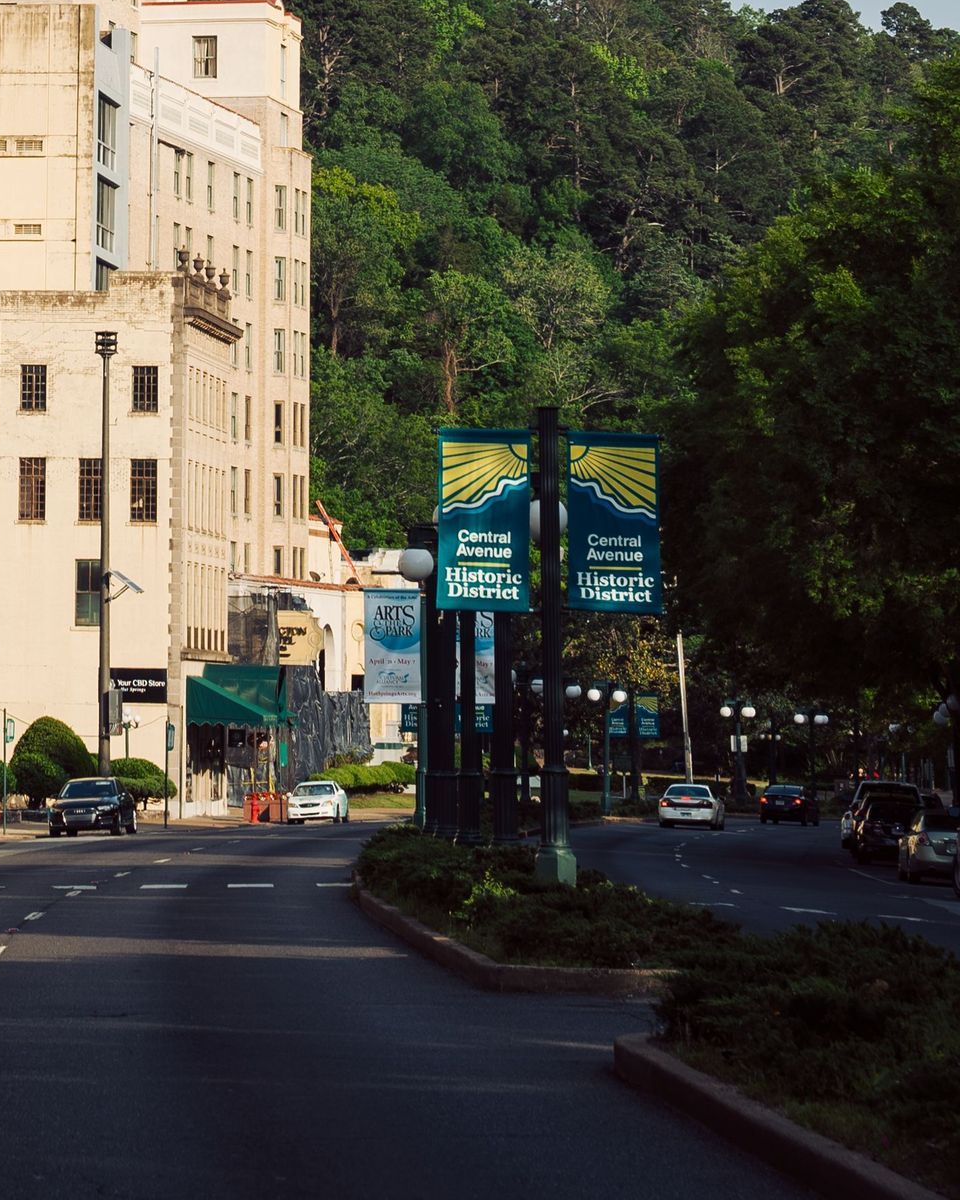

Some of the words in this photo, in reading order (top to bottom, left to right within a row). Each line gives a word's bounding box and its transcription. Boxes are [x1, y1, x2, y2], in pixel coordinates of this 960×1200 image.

[457, 529, 511, 544] Central
[587, 533, 642, 548] Central
[456, 544, 512, 559] Avenue
[586, 548, 644, 562] Avenue
[444, 567, 522, 585] Historic
[576, 571, 655, 588] Historic
[447, 583, 520, 600] District
[580, 587, 653, 603] District
[374, 605, 416, 626] ARTS
[385, 626, 413, 637] PARK
[117, 679, 132, 687] Your
[132, 679, 148, 687] CBD
[148, 679, 166, 687] Store
